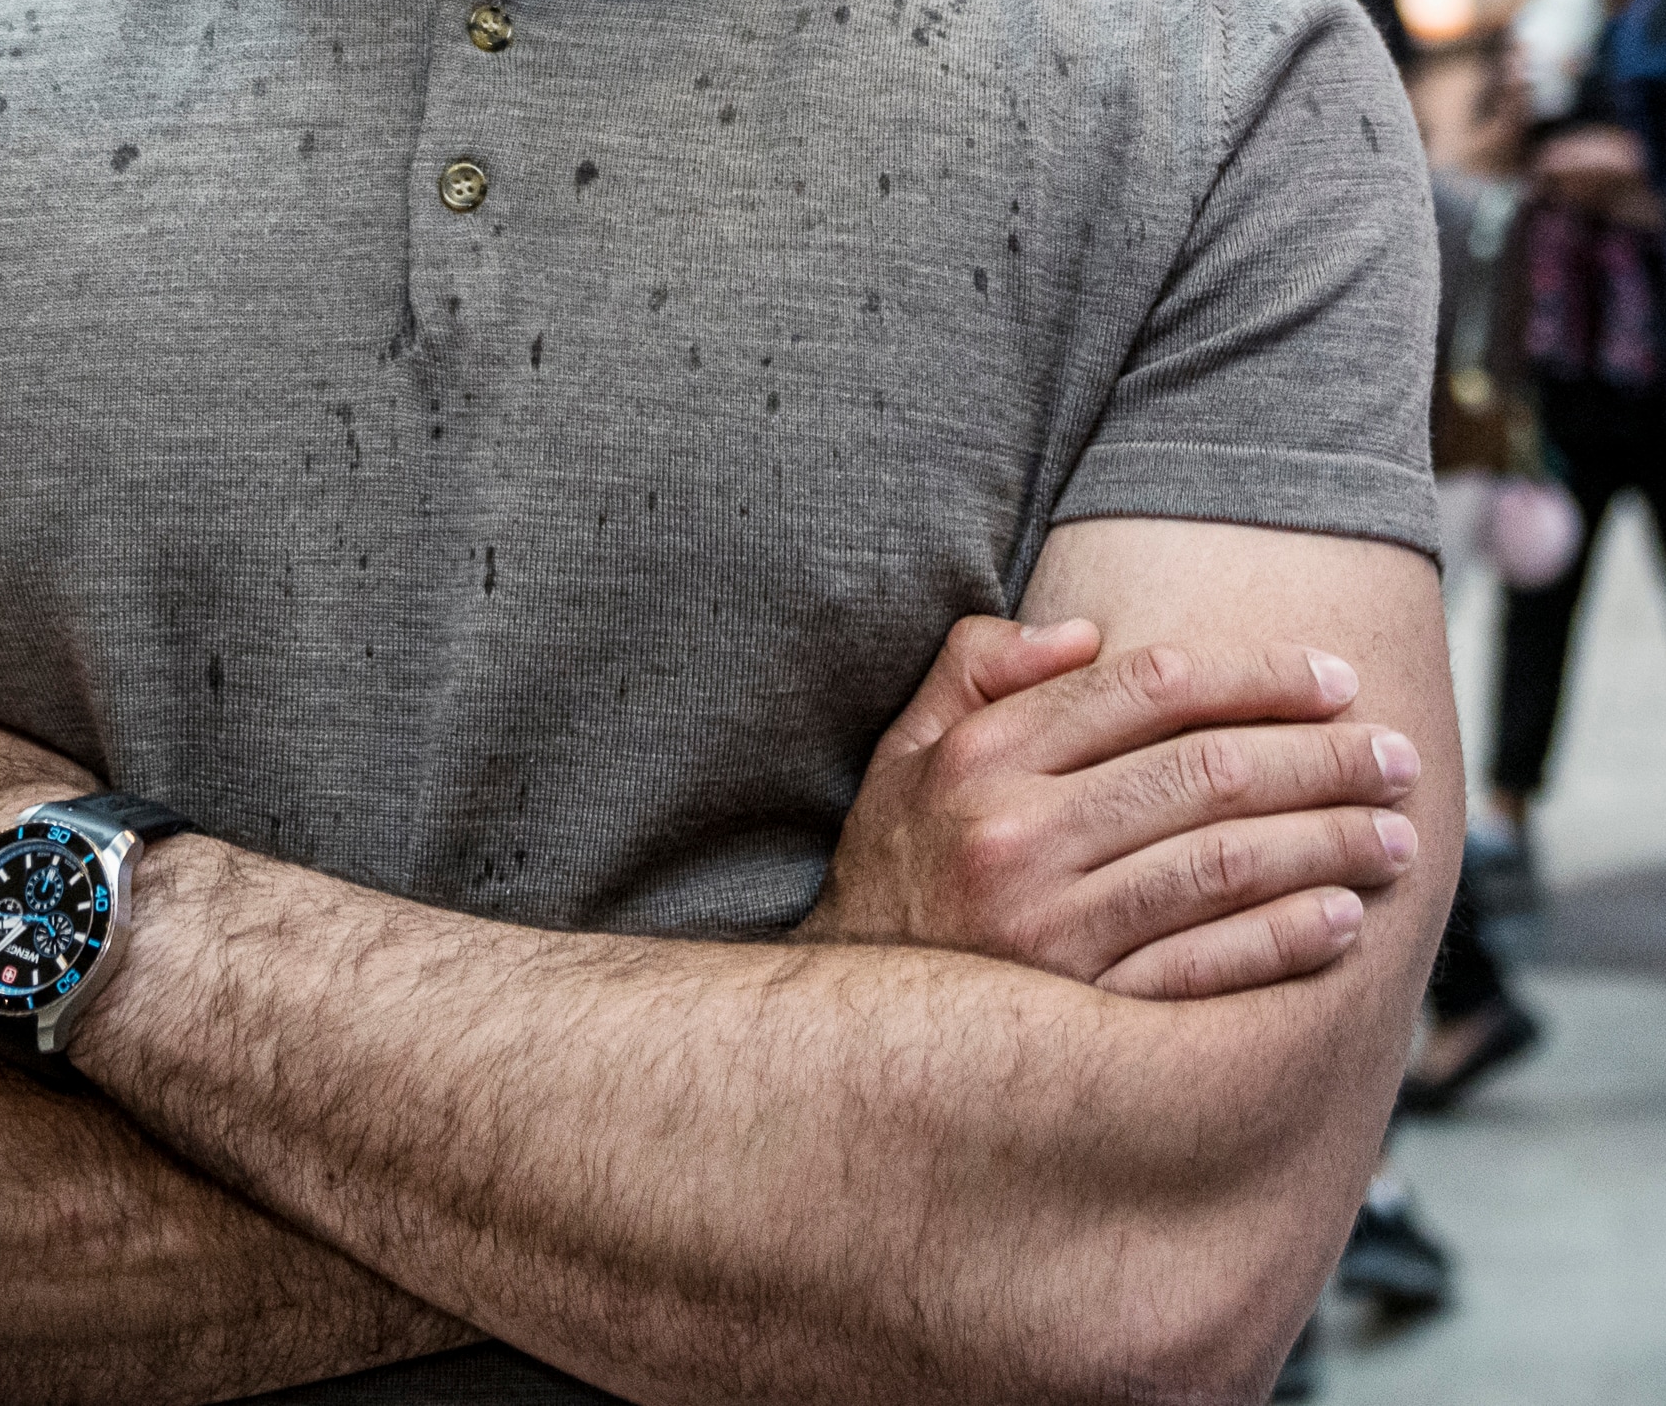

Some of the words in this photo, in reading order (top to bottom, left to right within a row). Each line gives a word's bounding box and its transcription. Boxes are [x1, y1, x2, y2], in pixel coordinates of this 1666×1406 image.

[47, 826, 71, 844] 30
[95, 885, 108, 912] 40
[4, 943, 39, 964] WENGE
[56, 968, 81, 994] 50
